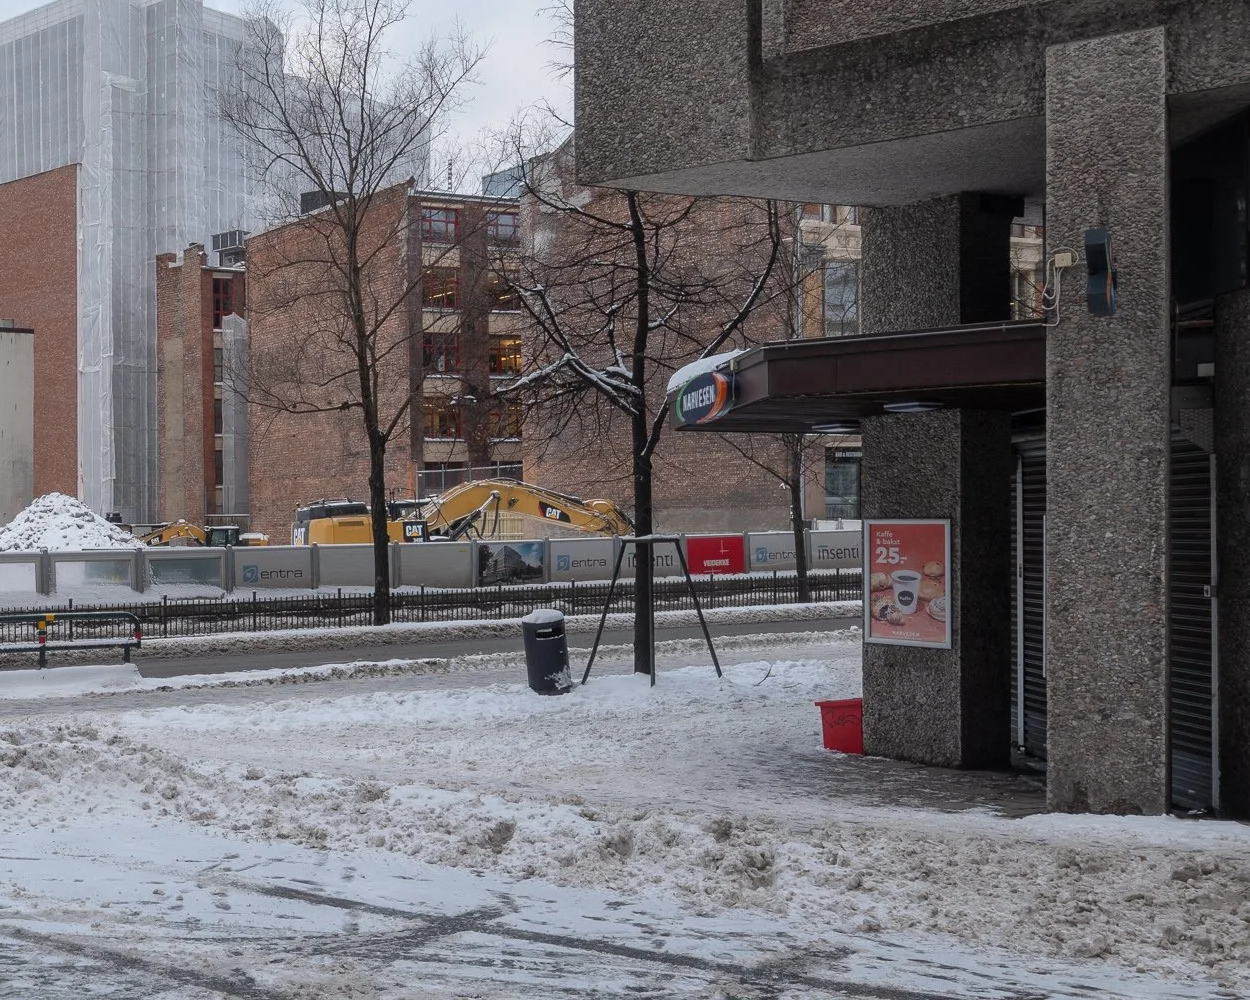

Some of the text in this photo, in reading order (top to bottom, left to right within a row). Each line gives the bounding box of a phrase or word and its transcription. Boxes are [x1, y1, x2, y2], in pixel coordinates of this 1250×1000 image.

[682, 384, 715, 411] NARVESEN
[546, 507, 561, 519] CAT
[405, 525, 423, 536] CAT
[293, 528, 306, 545] CAT
[768, 550, 797, 560] entra
[817, 544, 860, 560] insenti
[571, 557, 607, 568] entra
[703, 559, 730, 567] VEIDEKKE
[260, 569, 303, 580] entra
